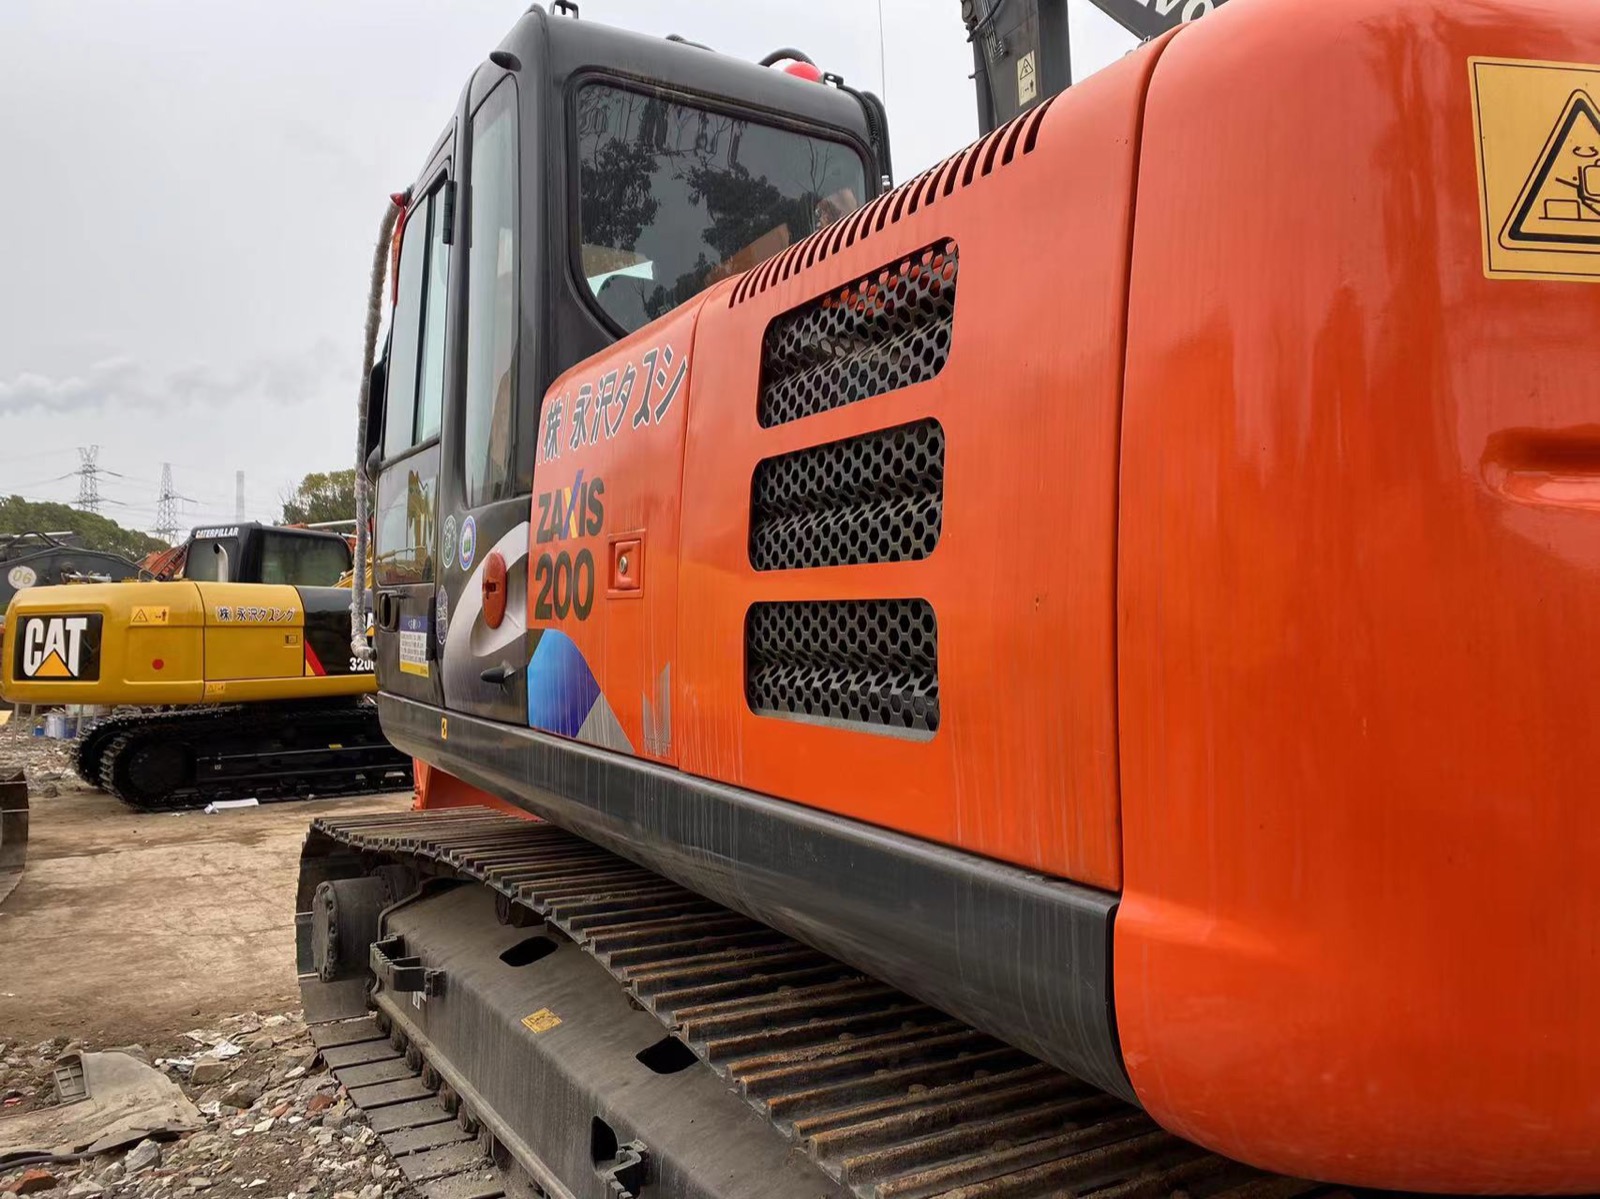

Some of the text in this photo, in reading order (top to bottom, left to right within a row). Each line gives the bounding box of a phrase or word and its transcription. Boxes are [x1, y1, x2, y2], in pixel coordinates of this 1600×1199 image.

[195, 526, 239, 539] CATERPILLAR
[537, 469, 604, 544] ZAXIS
[535, 548, 594, 621] 200
[23, 617, 88, 677] CAT
